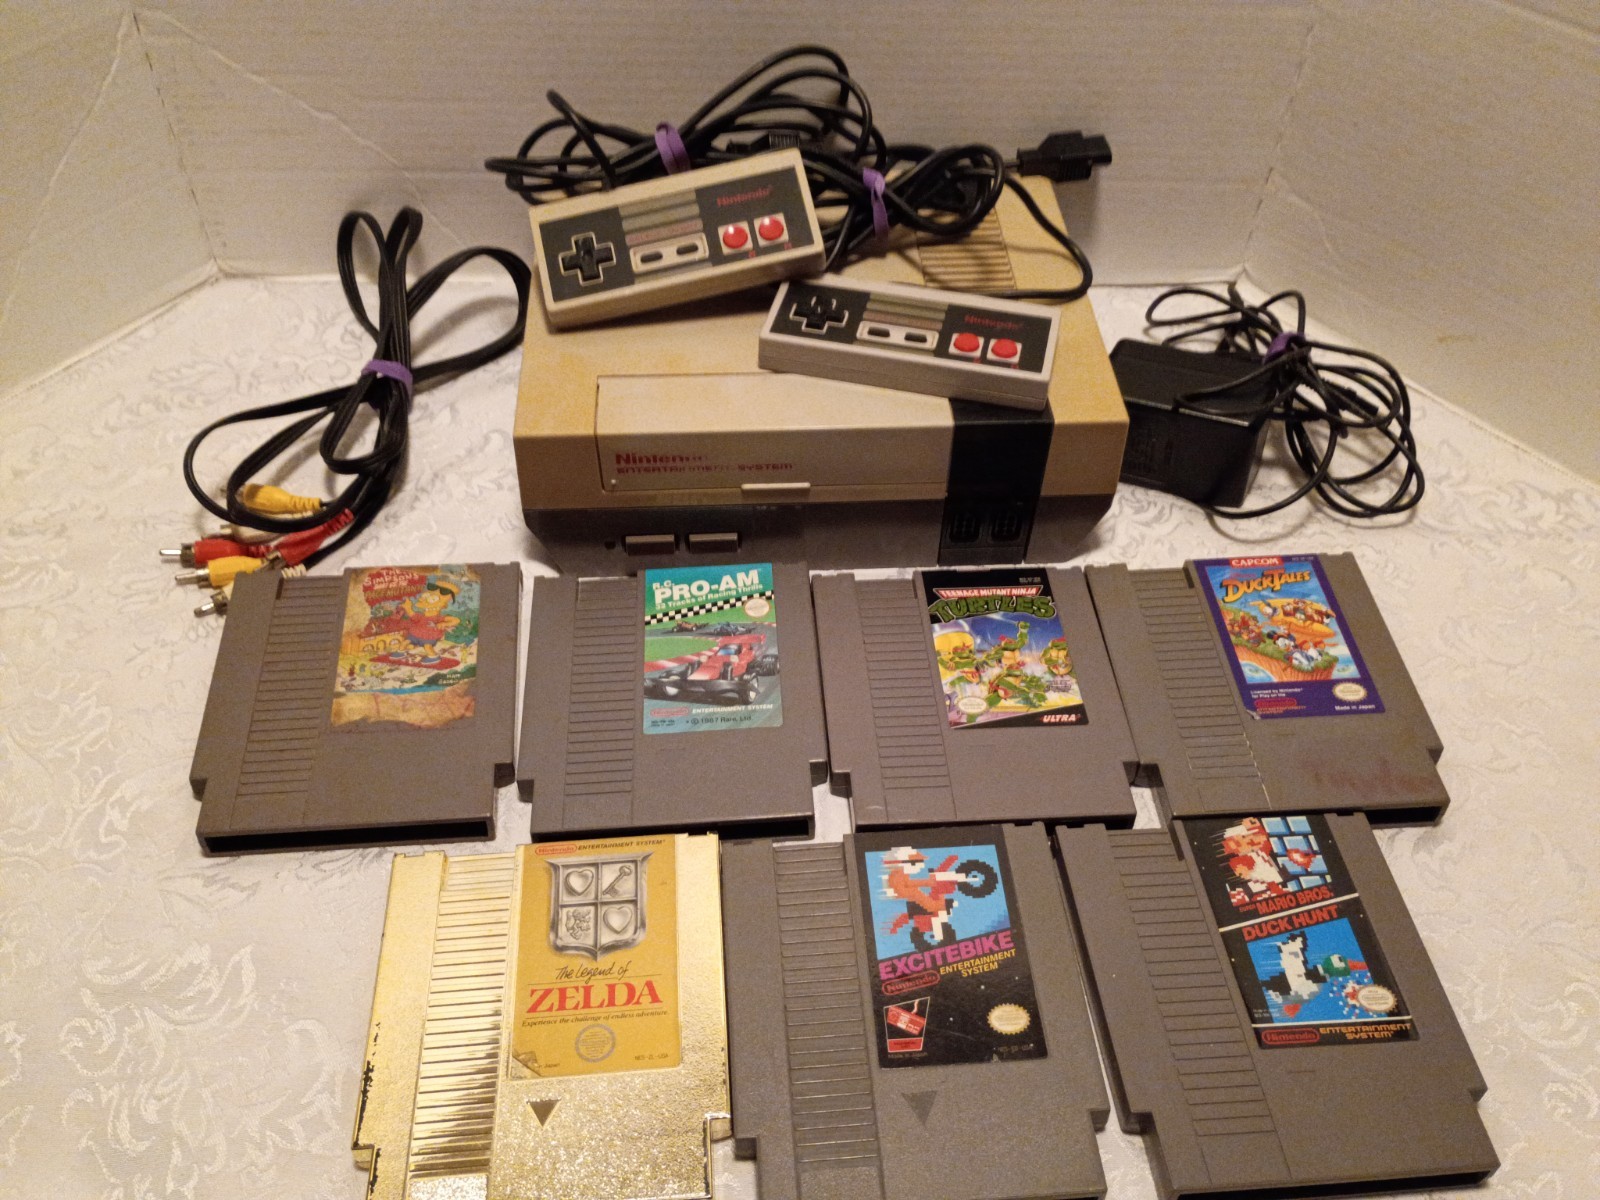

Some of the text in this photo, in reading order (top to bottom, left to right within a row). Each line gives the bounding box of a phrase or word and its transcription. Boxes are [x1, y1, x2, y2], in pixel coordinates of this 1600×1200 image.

[1231, 558, 1279, 566] CAPCOM
[654, 569, 760, 605] PRO-AM
[668, 597, 695, 608] Tracks
[697, 594, 706, 602] of
[708, 588, 737, 600] Racing
[738, 583, 763, 593] Thrills
[939, 586, 1036, 598] TEENAGE MUTANT NINJA
[928, 596, 1057, 623] TURTLES
[692, 705, 746, 714] ENTERTAINMENT
[1043, 714, 1076, 723] ULTRA
[578, 841, 633, 851] ENTERTAINMENT
[1256, 894, 1297, 915] MARIO
[1296, 886, 1334, 905] BROS.
[1242, 904, 1338, 941] DUCK HUNT
[878, 930, 1015, 981] EXCITEBIKE
[939, 948, 1017, 976] ENTERTAINMENT
[556, 960, 633, 984] The Legend of
[961, 962, 998, 978] SYSTEM
[887, 974, 937, 994] Nintendo
[526, 979, 663, 1013] ZELDA
[522, 1018, 558, 1028] Experience
[571, 1014, 602, 1024] challenge
[1265, 1023, 1412, 1042] Nintendo ENTERTAINMENT
[1346, 1031, 1392, 1040] SYSTEM
